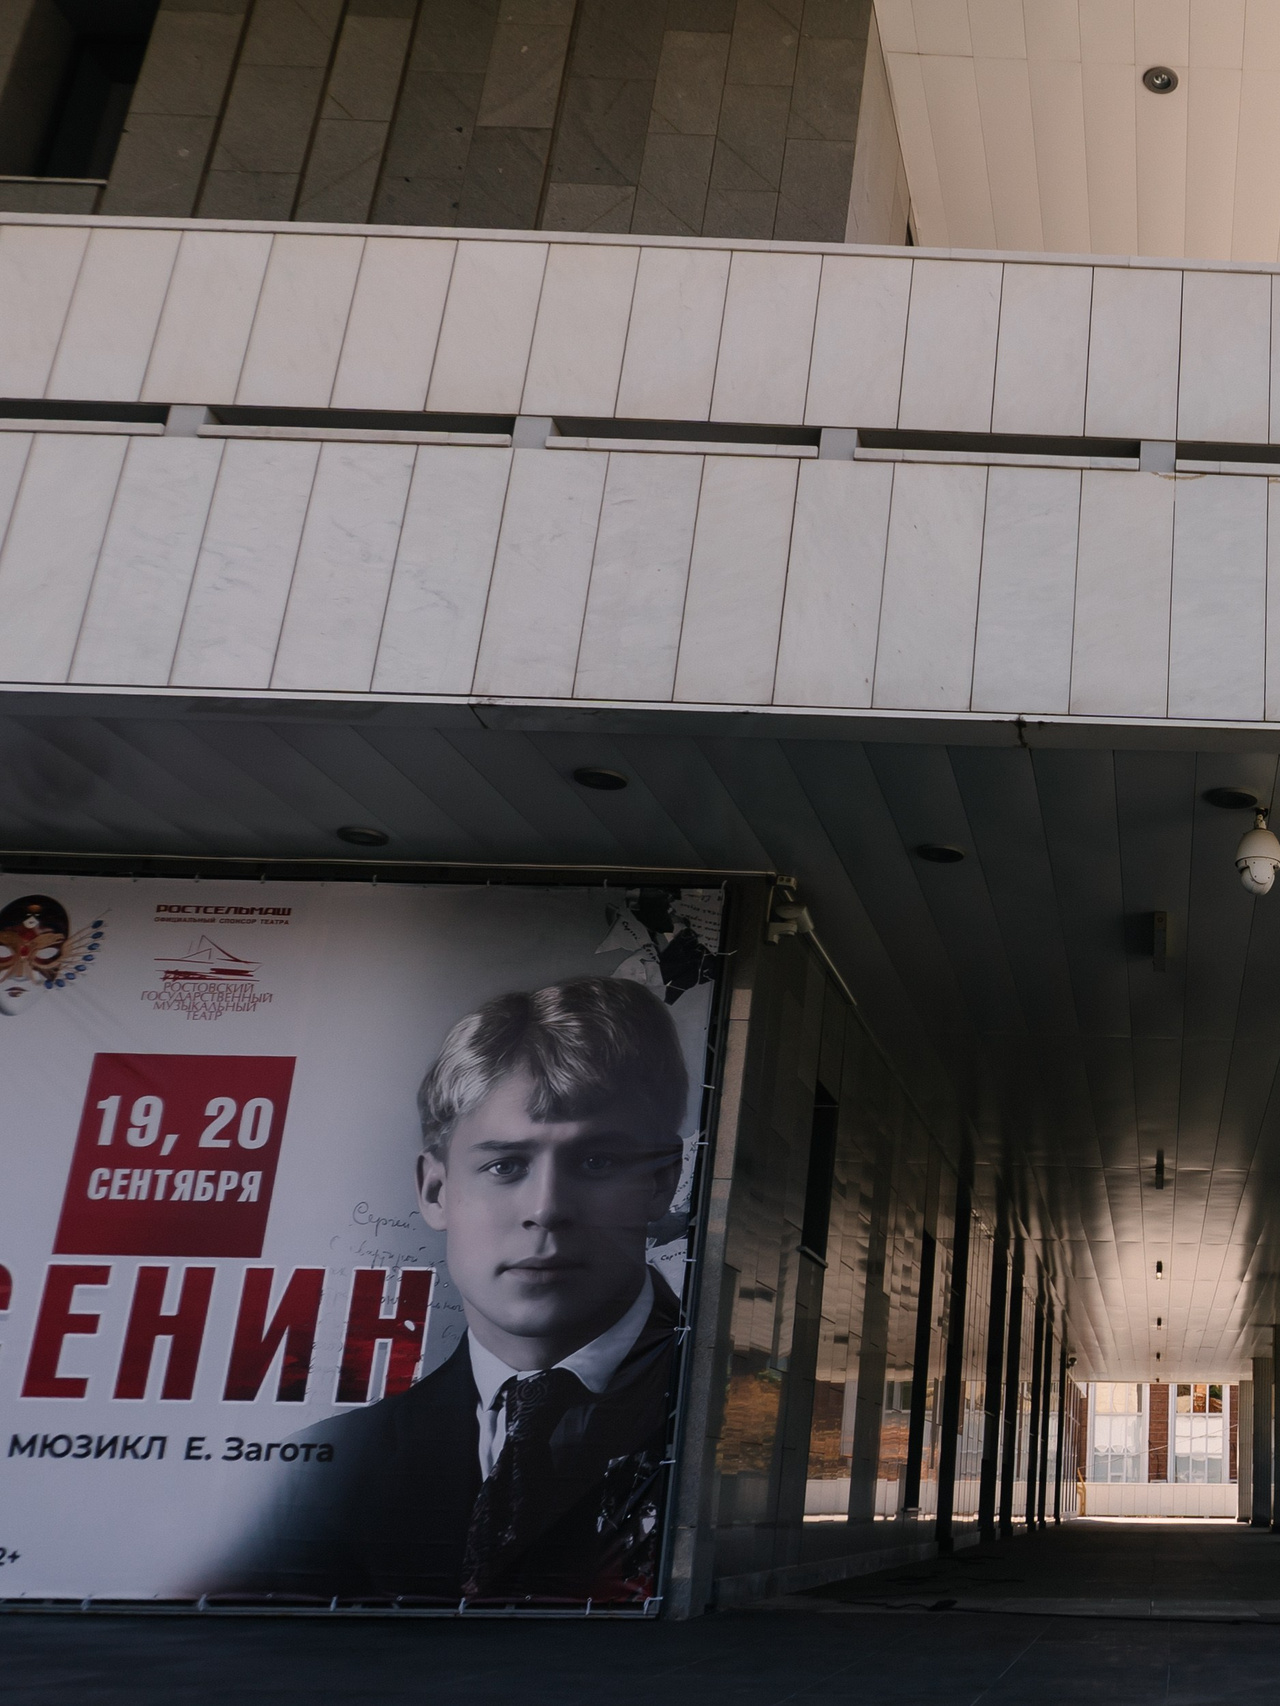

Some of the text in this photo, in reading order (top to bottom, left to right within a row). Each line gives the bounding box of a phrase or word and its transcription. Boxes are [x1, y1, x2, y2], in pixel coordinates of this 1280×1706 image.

[156, 904, 292, 916] РОСТСЕЛЬМАШ
[154, 916, 290, 926] ОФИЦИАЛЬНЫЙ СПОНСОР ТЕАТРА
[163, 982, 255, 993] РОСТОВСКИЙ
[140, 990, 273, 1003] ГОСУДАРСТВЕННЫЙ
[152, 1000, 257, 1012] МУЗЫКАЛЬНЫЙ
[185, 1010, 223, 1021] ТЕАТР
[97, 1094, 275, 1156] 19, 20
[87, 1167, 263, 1203] СЕНТЯБРЯ
[0, 1262, 436, 1405] ЕНИН
[7, 1433, 335, 1463] МЮЗИКЛ Е. Загота
